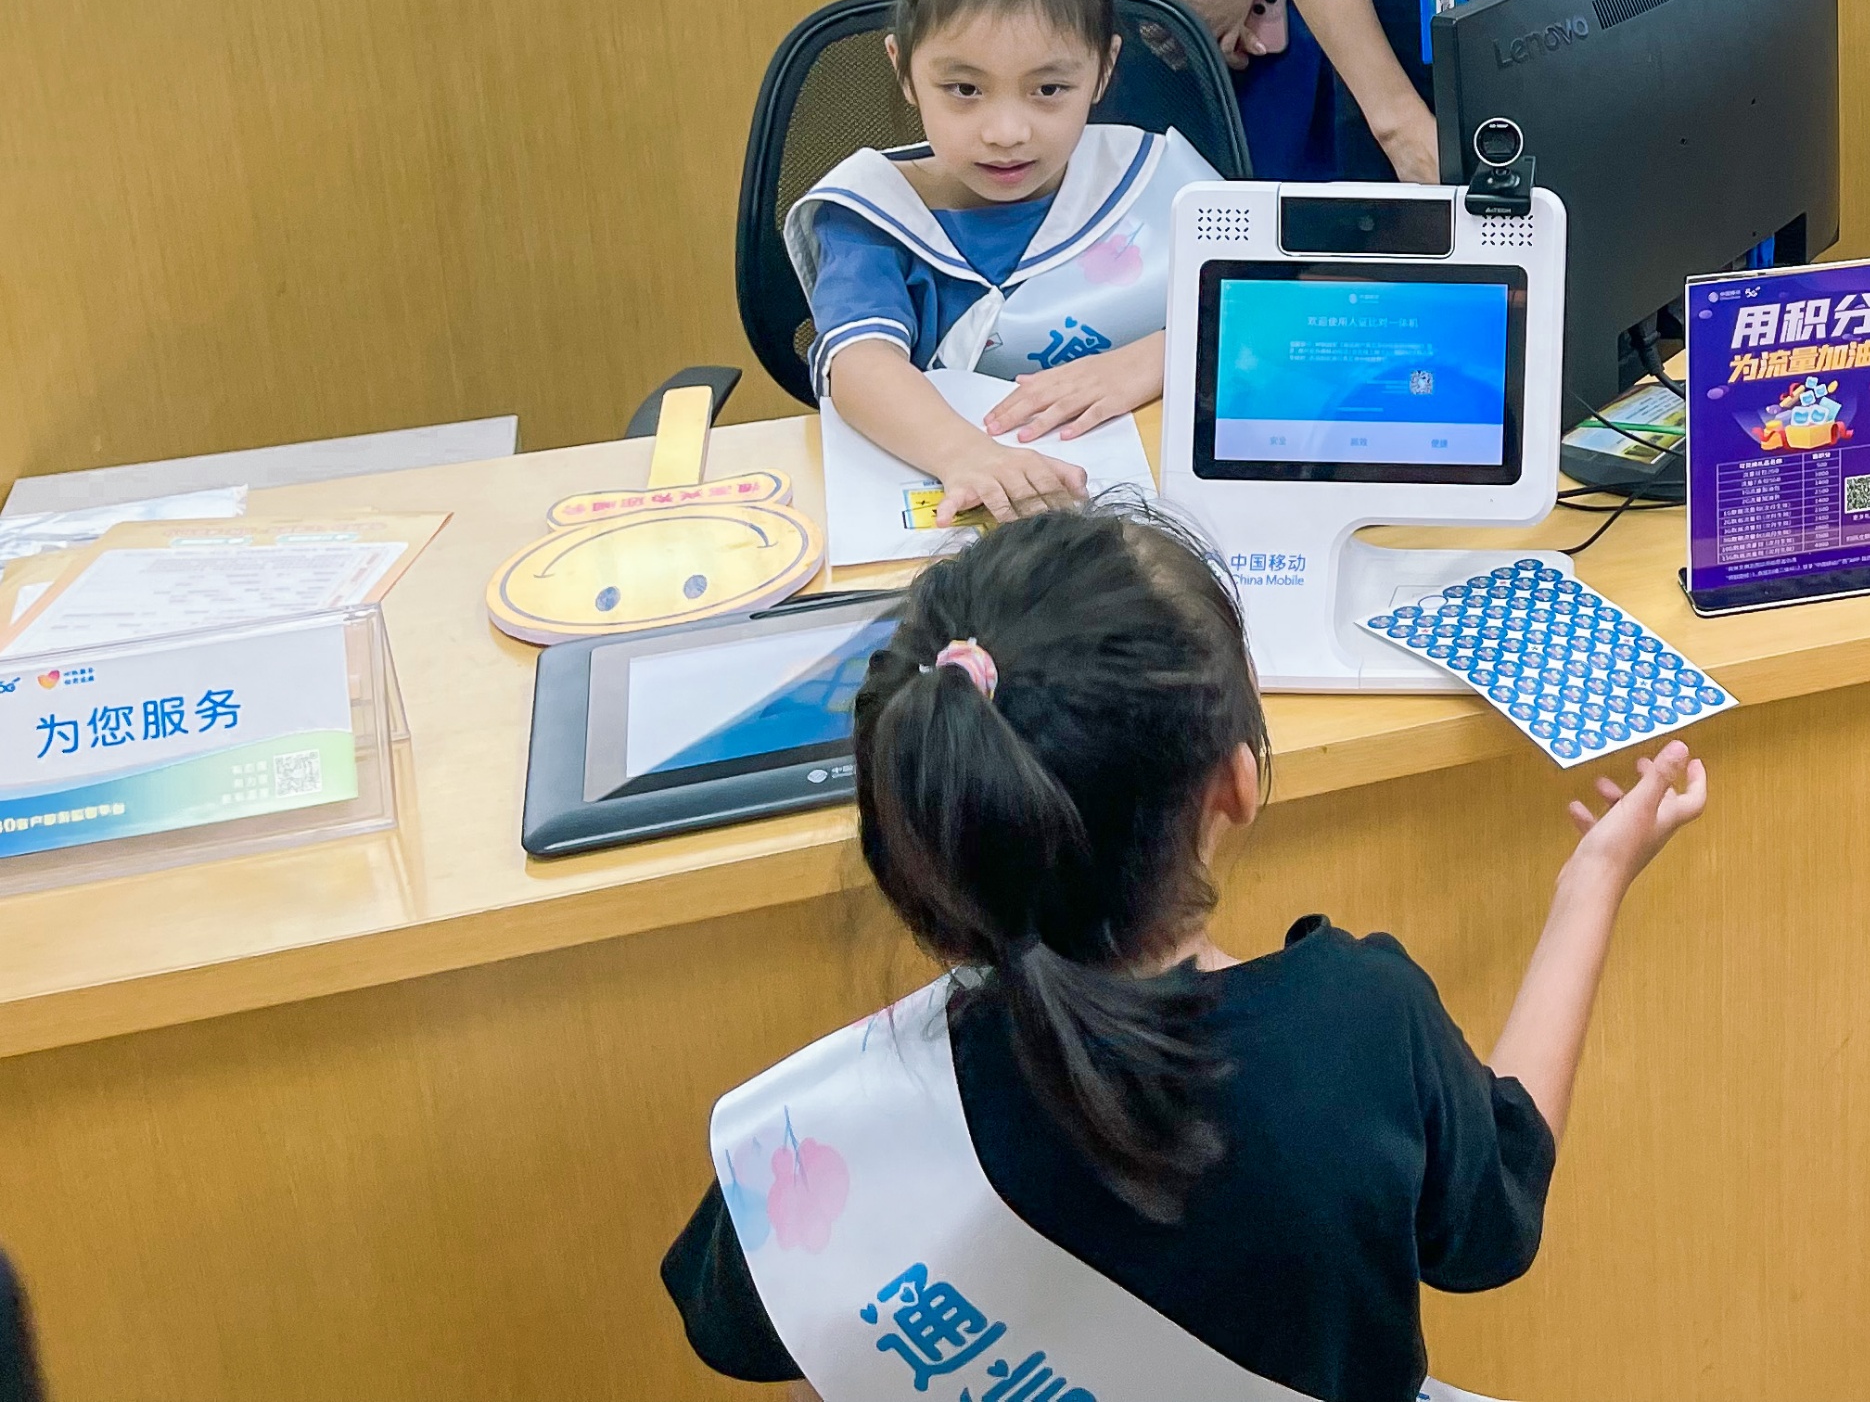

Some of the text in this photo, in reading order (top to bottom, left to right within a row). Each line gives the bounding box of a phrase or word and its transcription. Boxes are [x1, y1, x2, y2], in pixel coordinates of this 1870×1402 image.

[1493, 15, 1590, 70] Lenovo
[1231, 553, 1306, 572] 中国移动
[1266, 574, 1305, 586] Mobile
[36, 689, 242, 759] 为您服务
